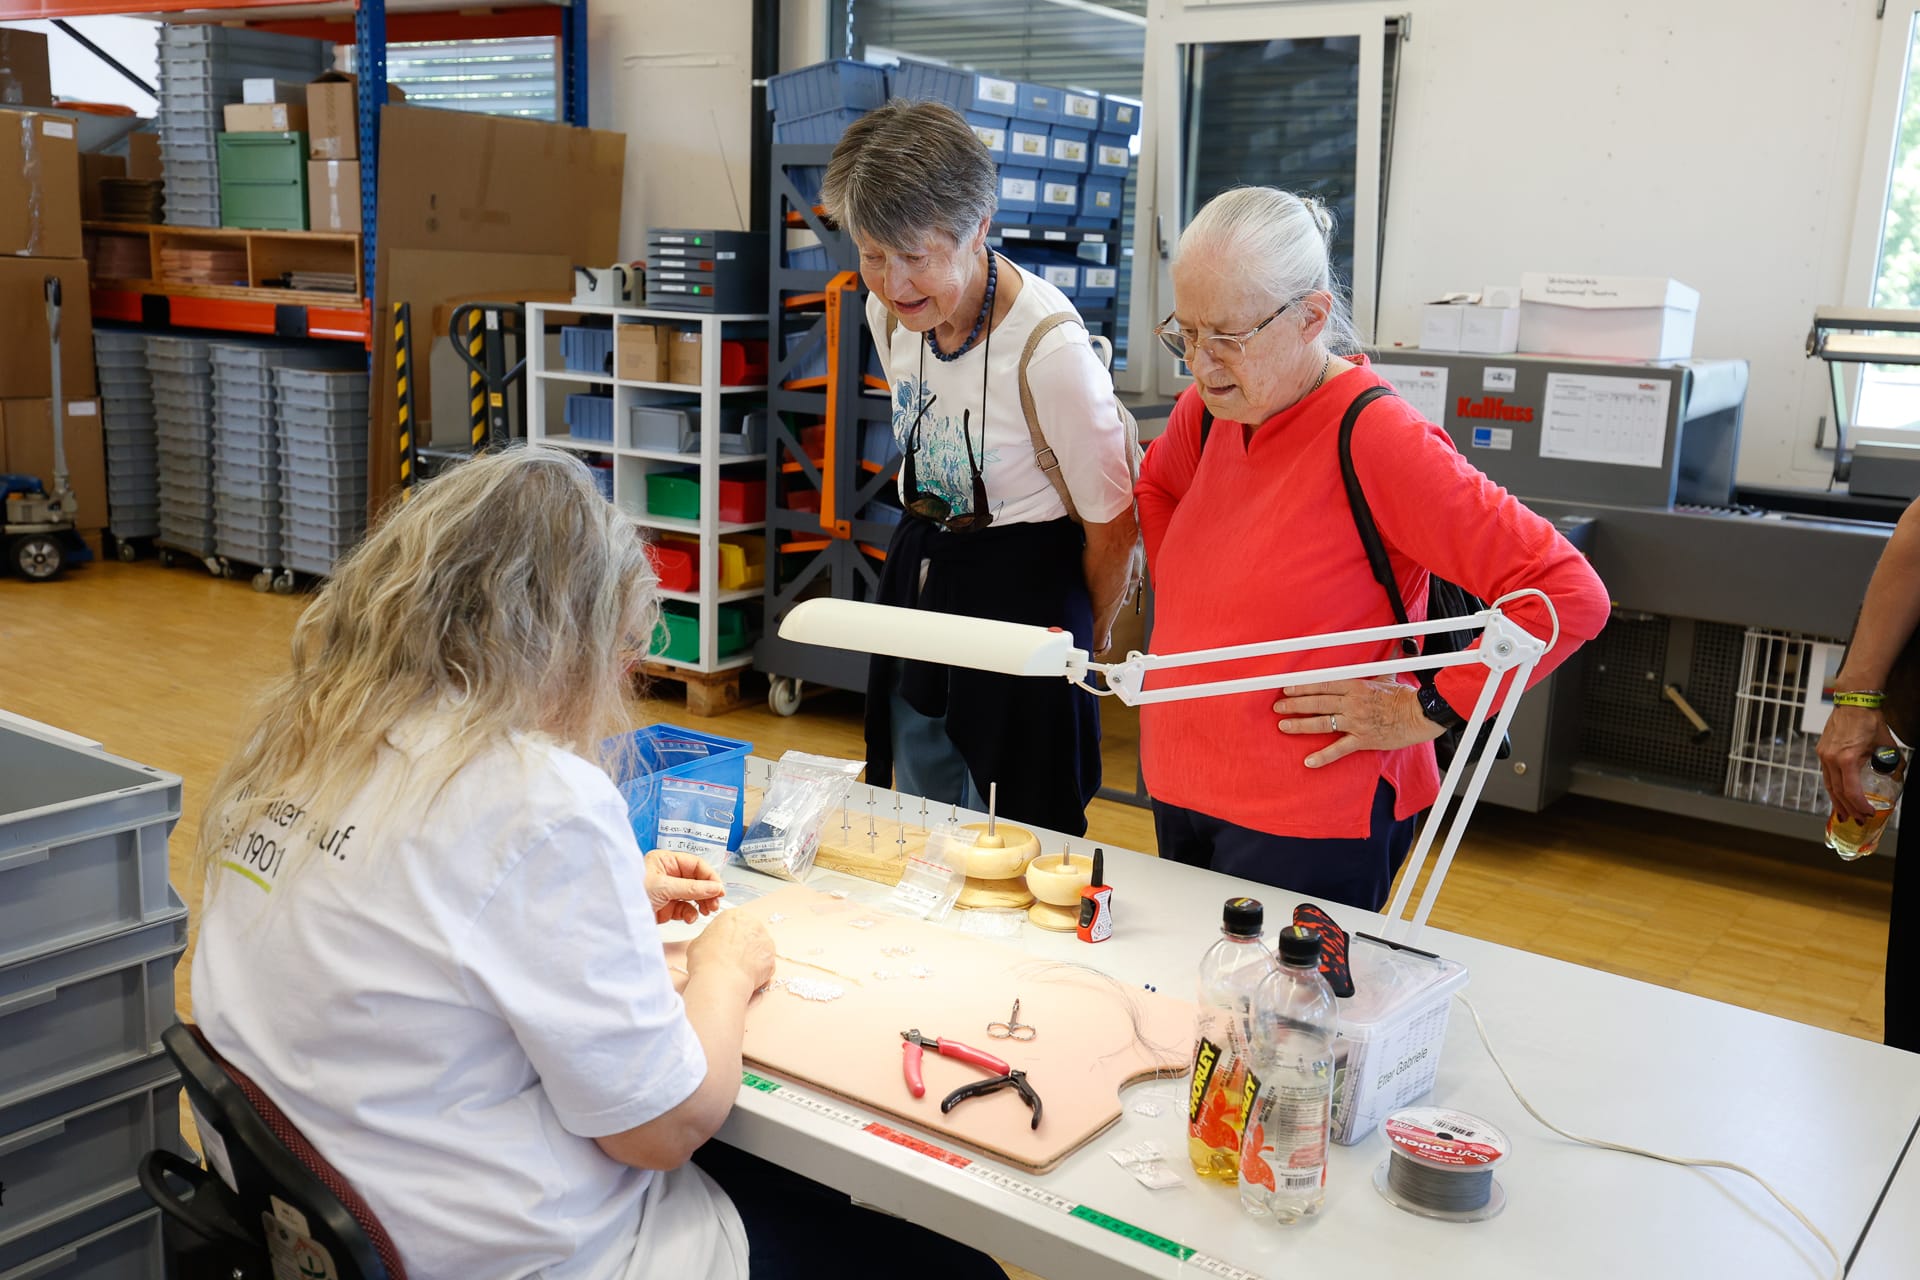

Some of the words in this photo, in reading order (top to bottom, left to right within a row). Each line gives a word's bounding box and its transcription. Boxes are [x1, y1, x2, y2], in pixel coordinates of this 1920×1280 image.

[1456, 396, 1534, 423] Kallfass
[243, 830, 286, 879] 1901
[307, 824, 356, 861] uf.
[1396, 1047, 1428, 1076] Gabriele
[1190, 1041, 1216, 1120] SHORLEY
